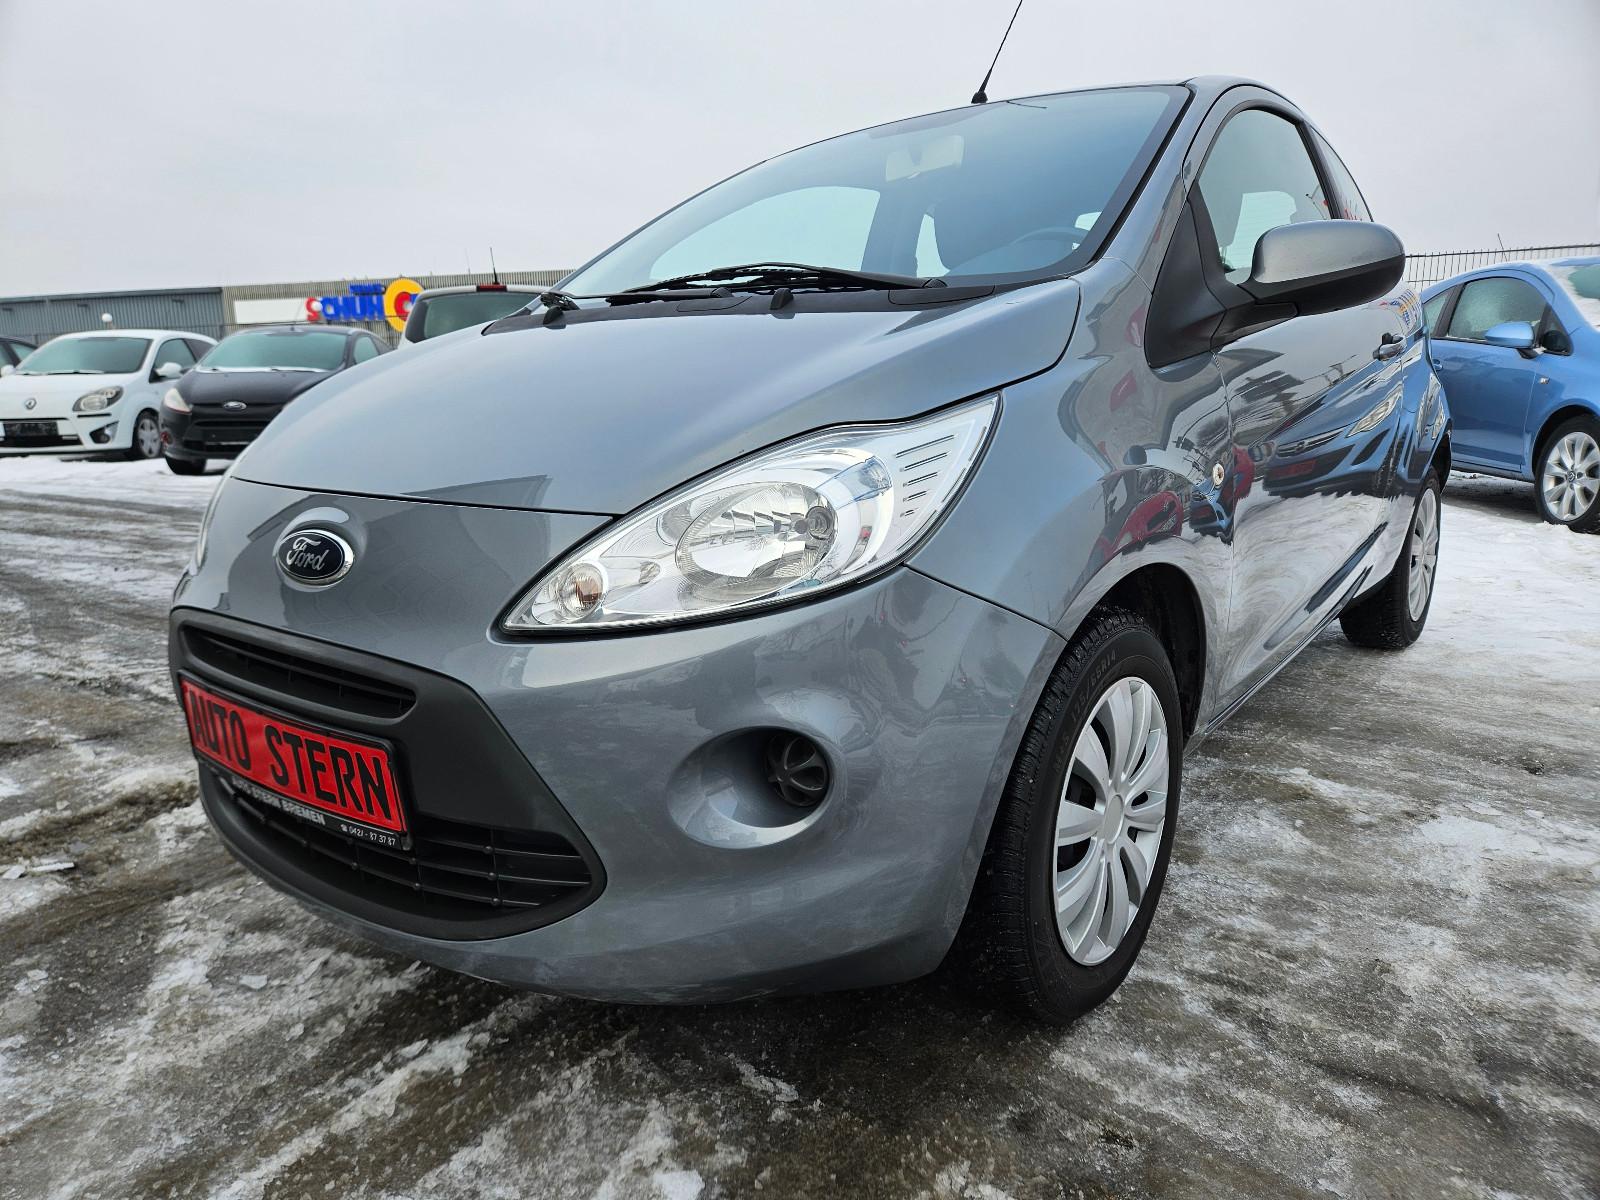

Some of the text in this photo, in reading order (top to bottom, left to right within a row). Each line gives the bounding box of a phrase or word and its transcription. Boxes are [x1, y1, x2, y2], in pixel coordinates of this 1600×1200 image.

[286, 536, 330, 571] Ford
[189, 689, 392, 821] AUTO STERN
[282, 800, 326, 826] BREMEN
